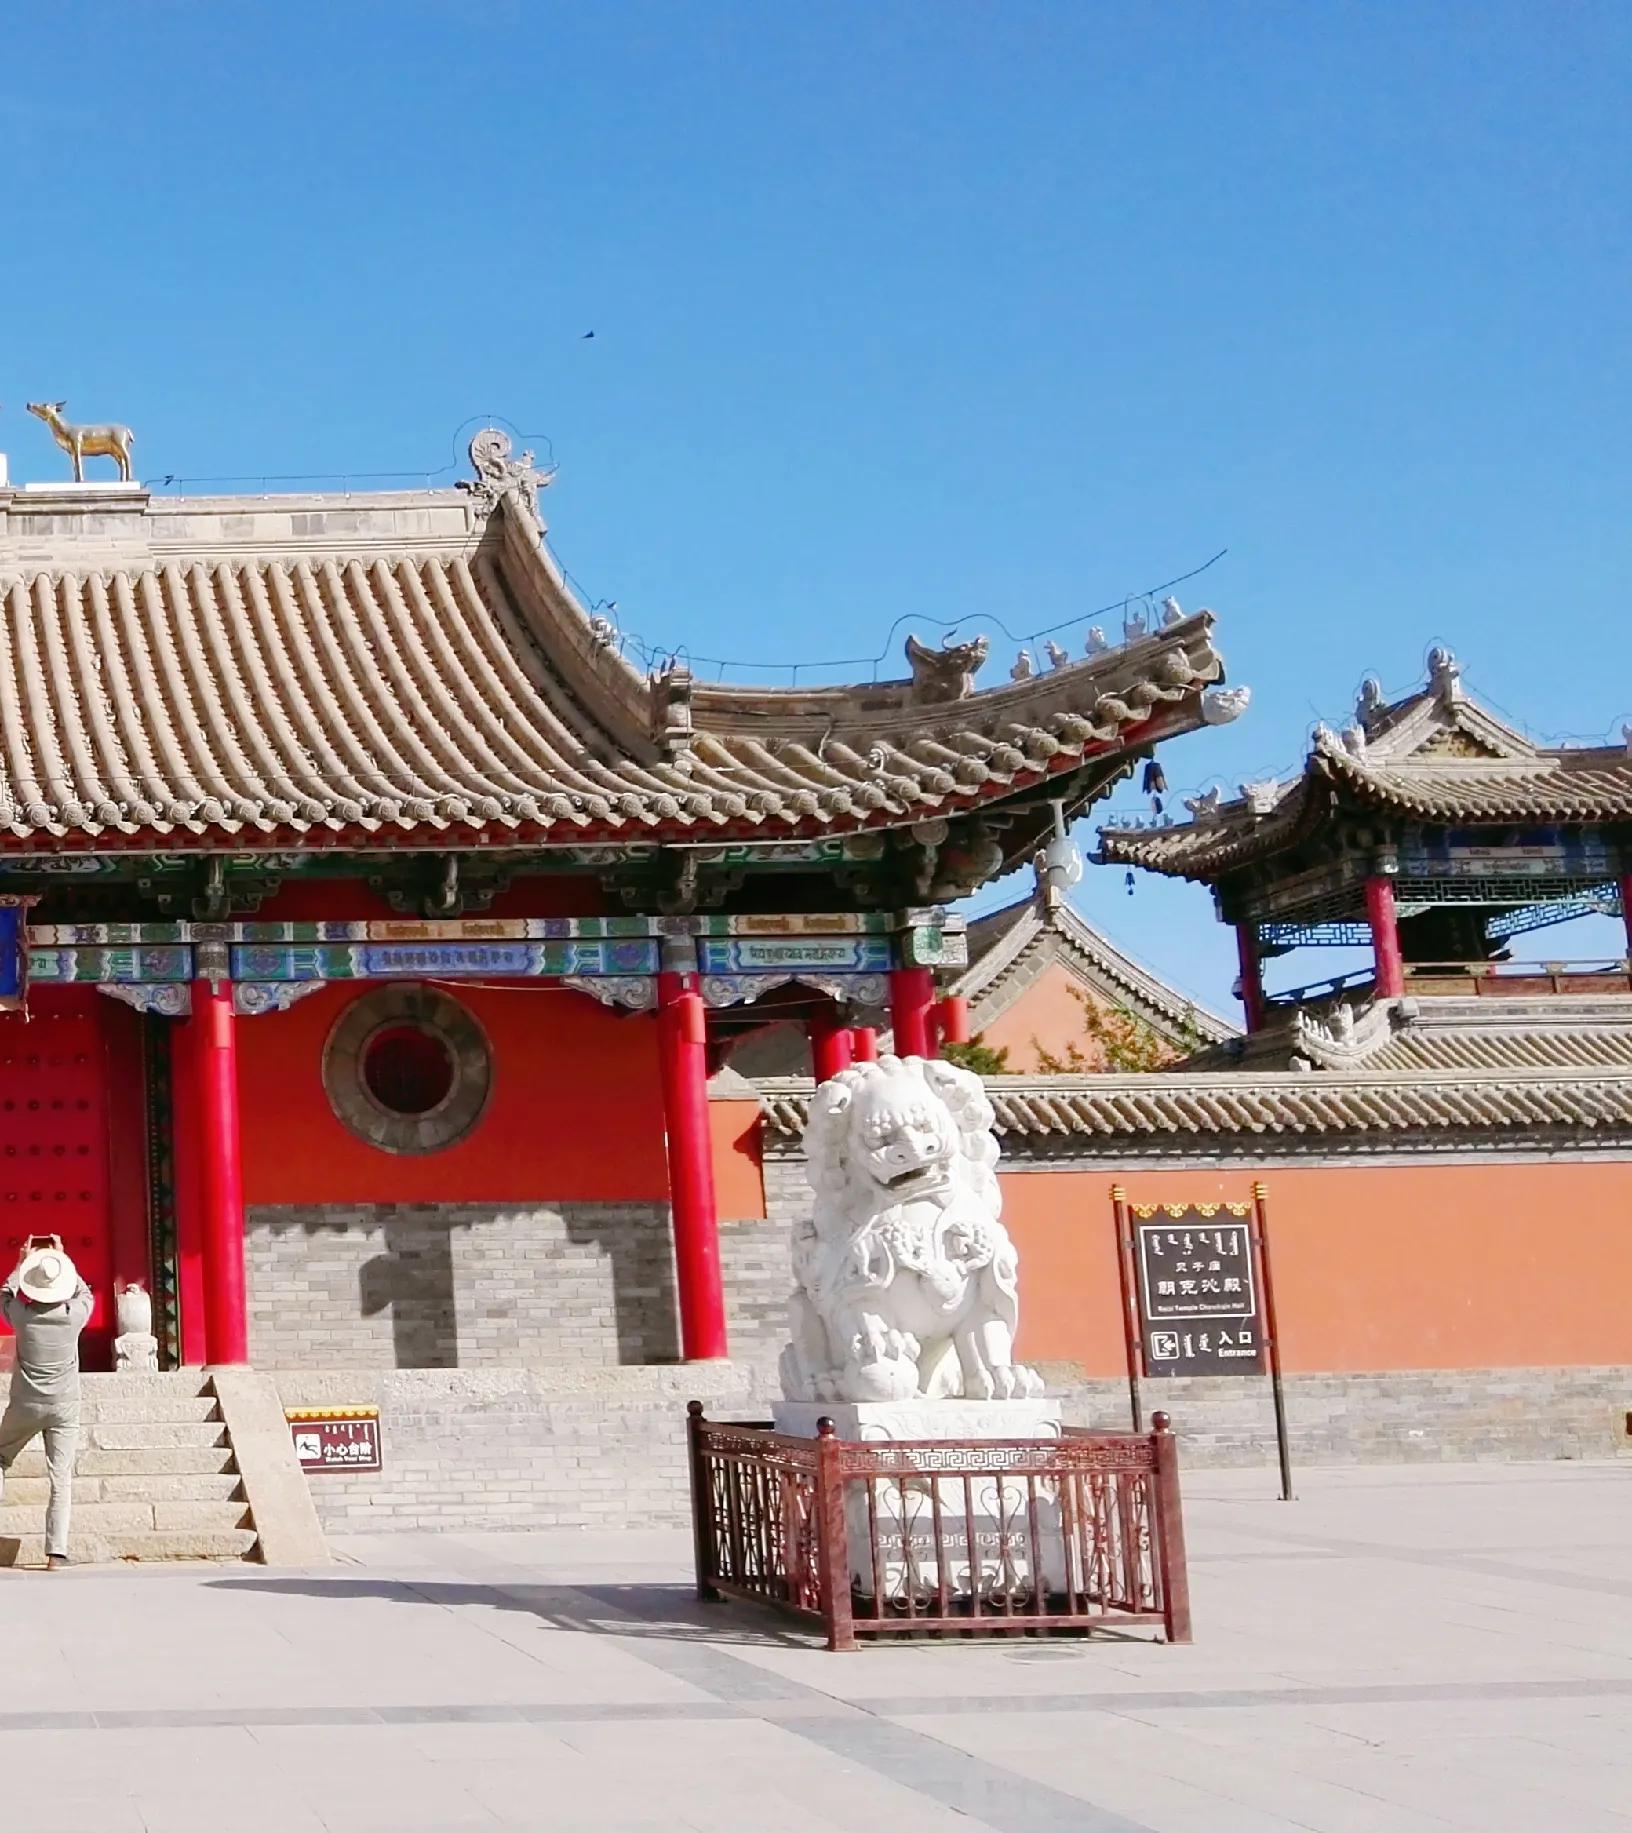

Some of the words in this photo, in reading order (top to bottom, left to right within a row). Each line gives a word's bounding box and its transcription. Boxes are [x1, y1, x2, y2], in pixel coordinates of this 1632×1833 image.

[1218, 1331, 1252, 1345] 入口
[1218, 1347, 1257, 1358] Entrance
[323, 1442, 372, 1457] 小心台阶
